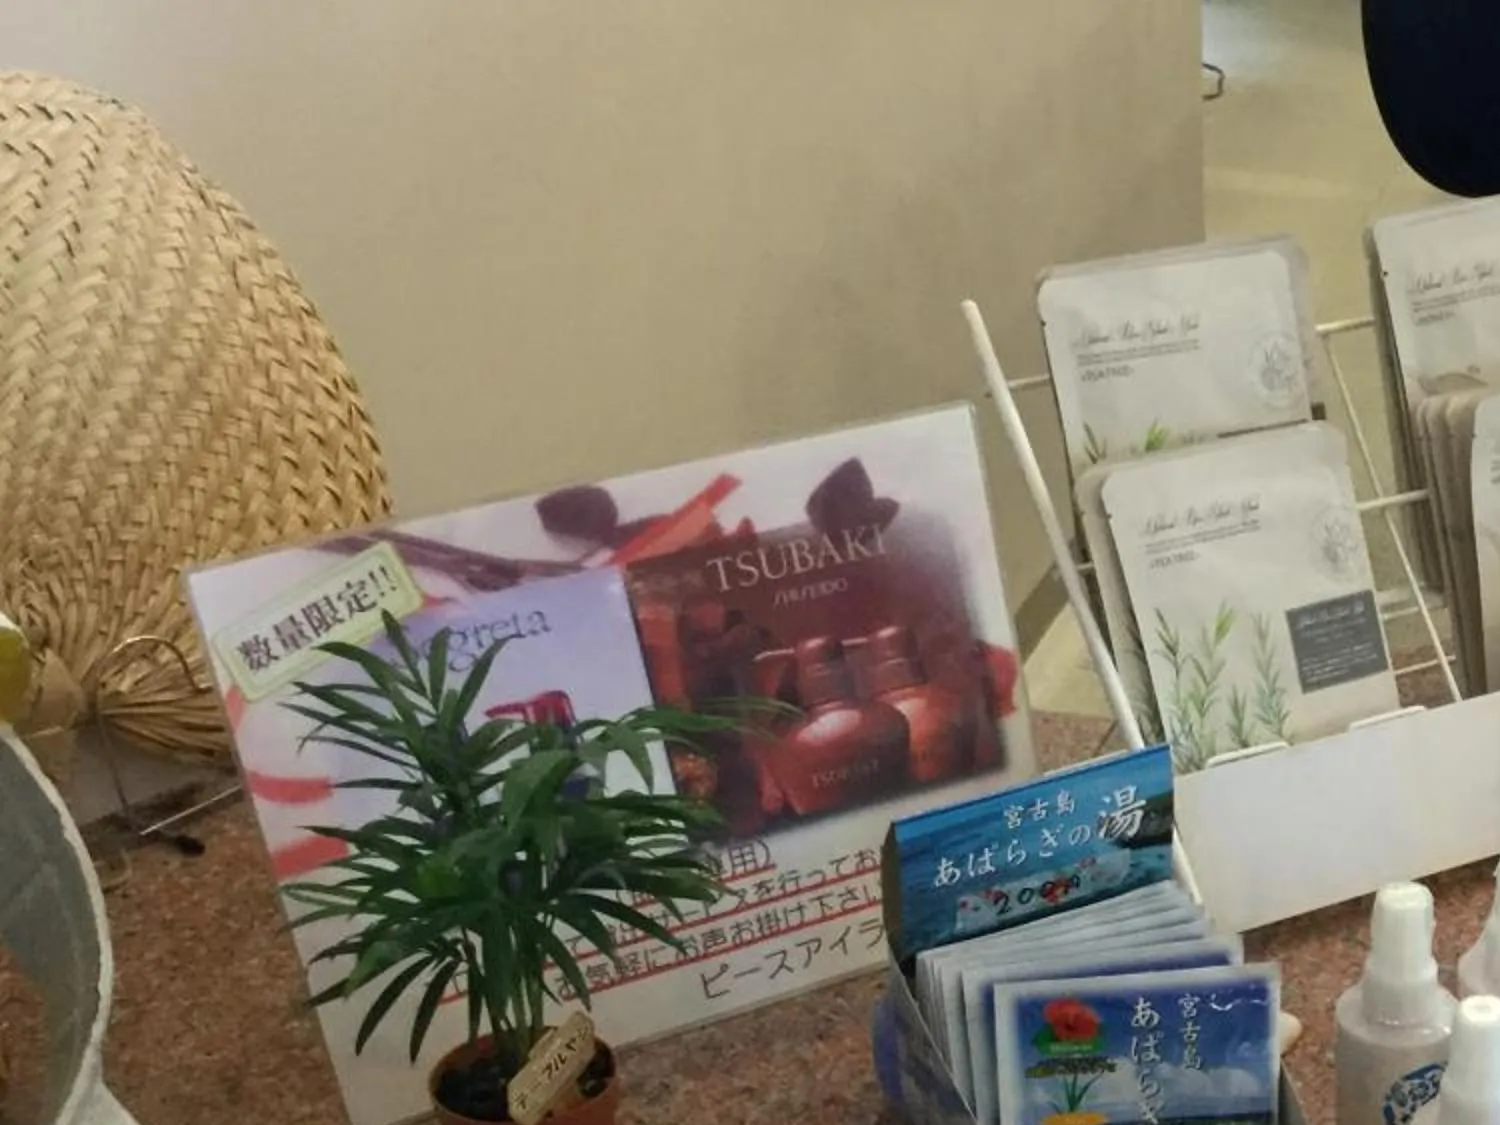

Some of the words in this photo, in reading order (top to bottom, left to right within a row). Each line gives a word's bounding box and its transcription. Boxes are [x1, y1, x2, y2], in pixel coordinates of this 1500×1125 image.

[706, 524, 888, 592] TSUBAKI
[235, 565, 398, 672] 数量限定!!
[1003, 789, 1075, 830] 宮古島
[1178, 992, 1201, 1070] 宮古島
